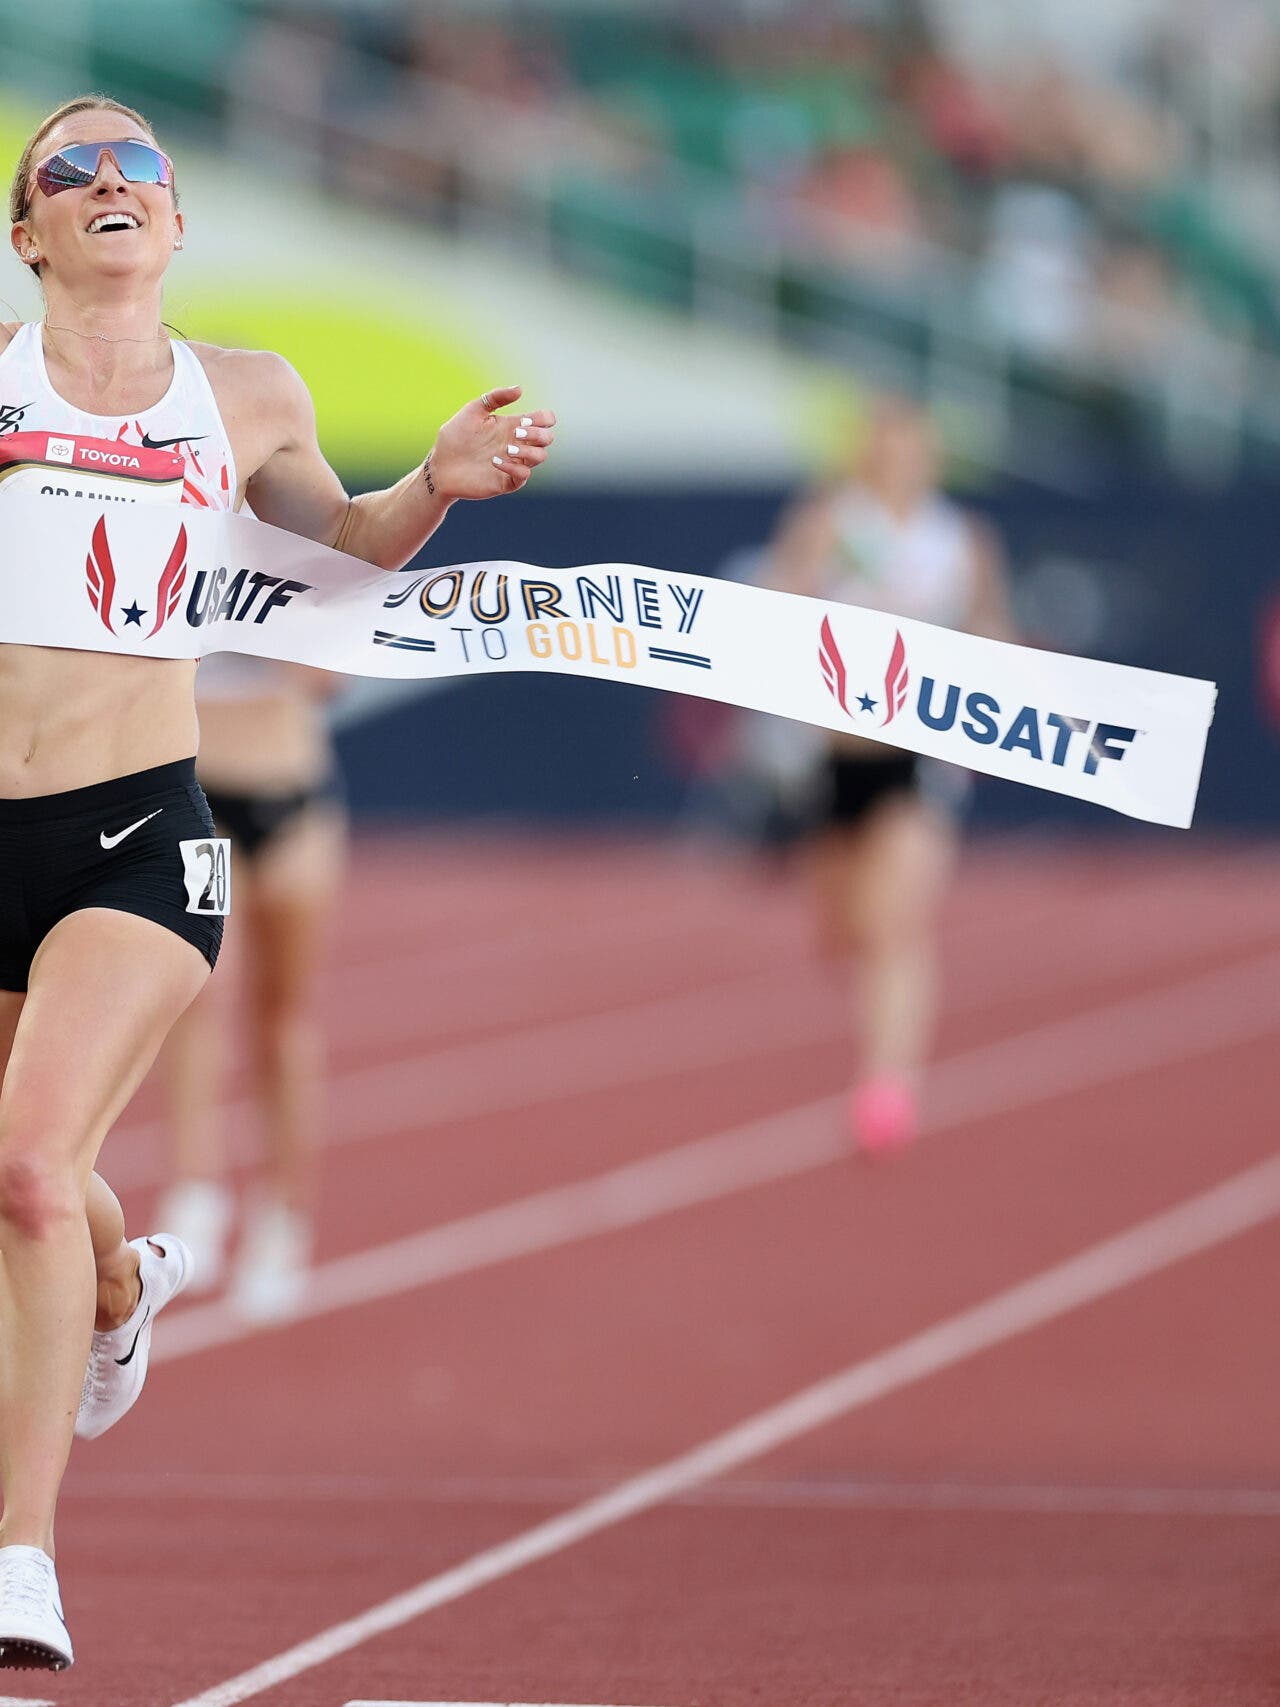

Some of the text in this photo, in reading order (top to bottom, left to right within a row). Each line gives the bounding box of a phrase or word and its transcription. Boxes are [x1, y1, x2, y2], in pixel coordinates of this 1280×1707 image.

[79, 448, 140, 468] TOYOTA
[185, 566, 313, 628] USATF
[383, 570, 704, 634] JOURNEY
[450, 621, 638, 669] TO GOLD
[916, 676, 1138, 776] USATF
[195, 843, 226, 912] 20
